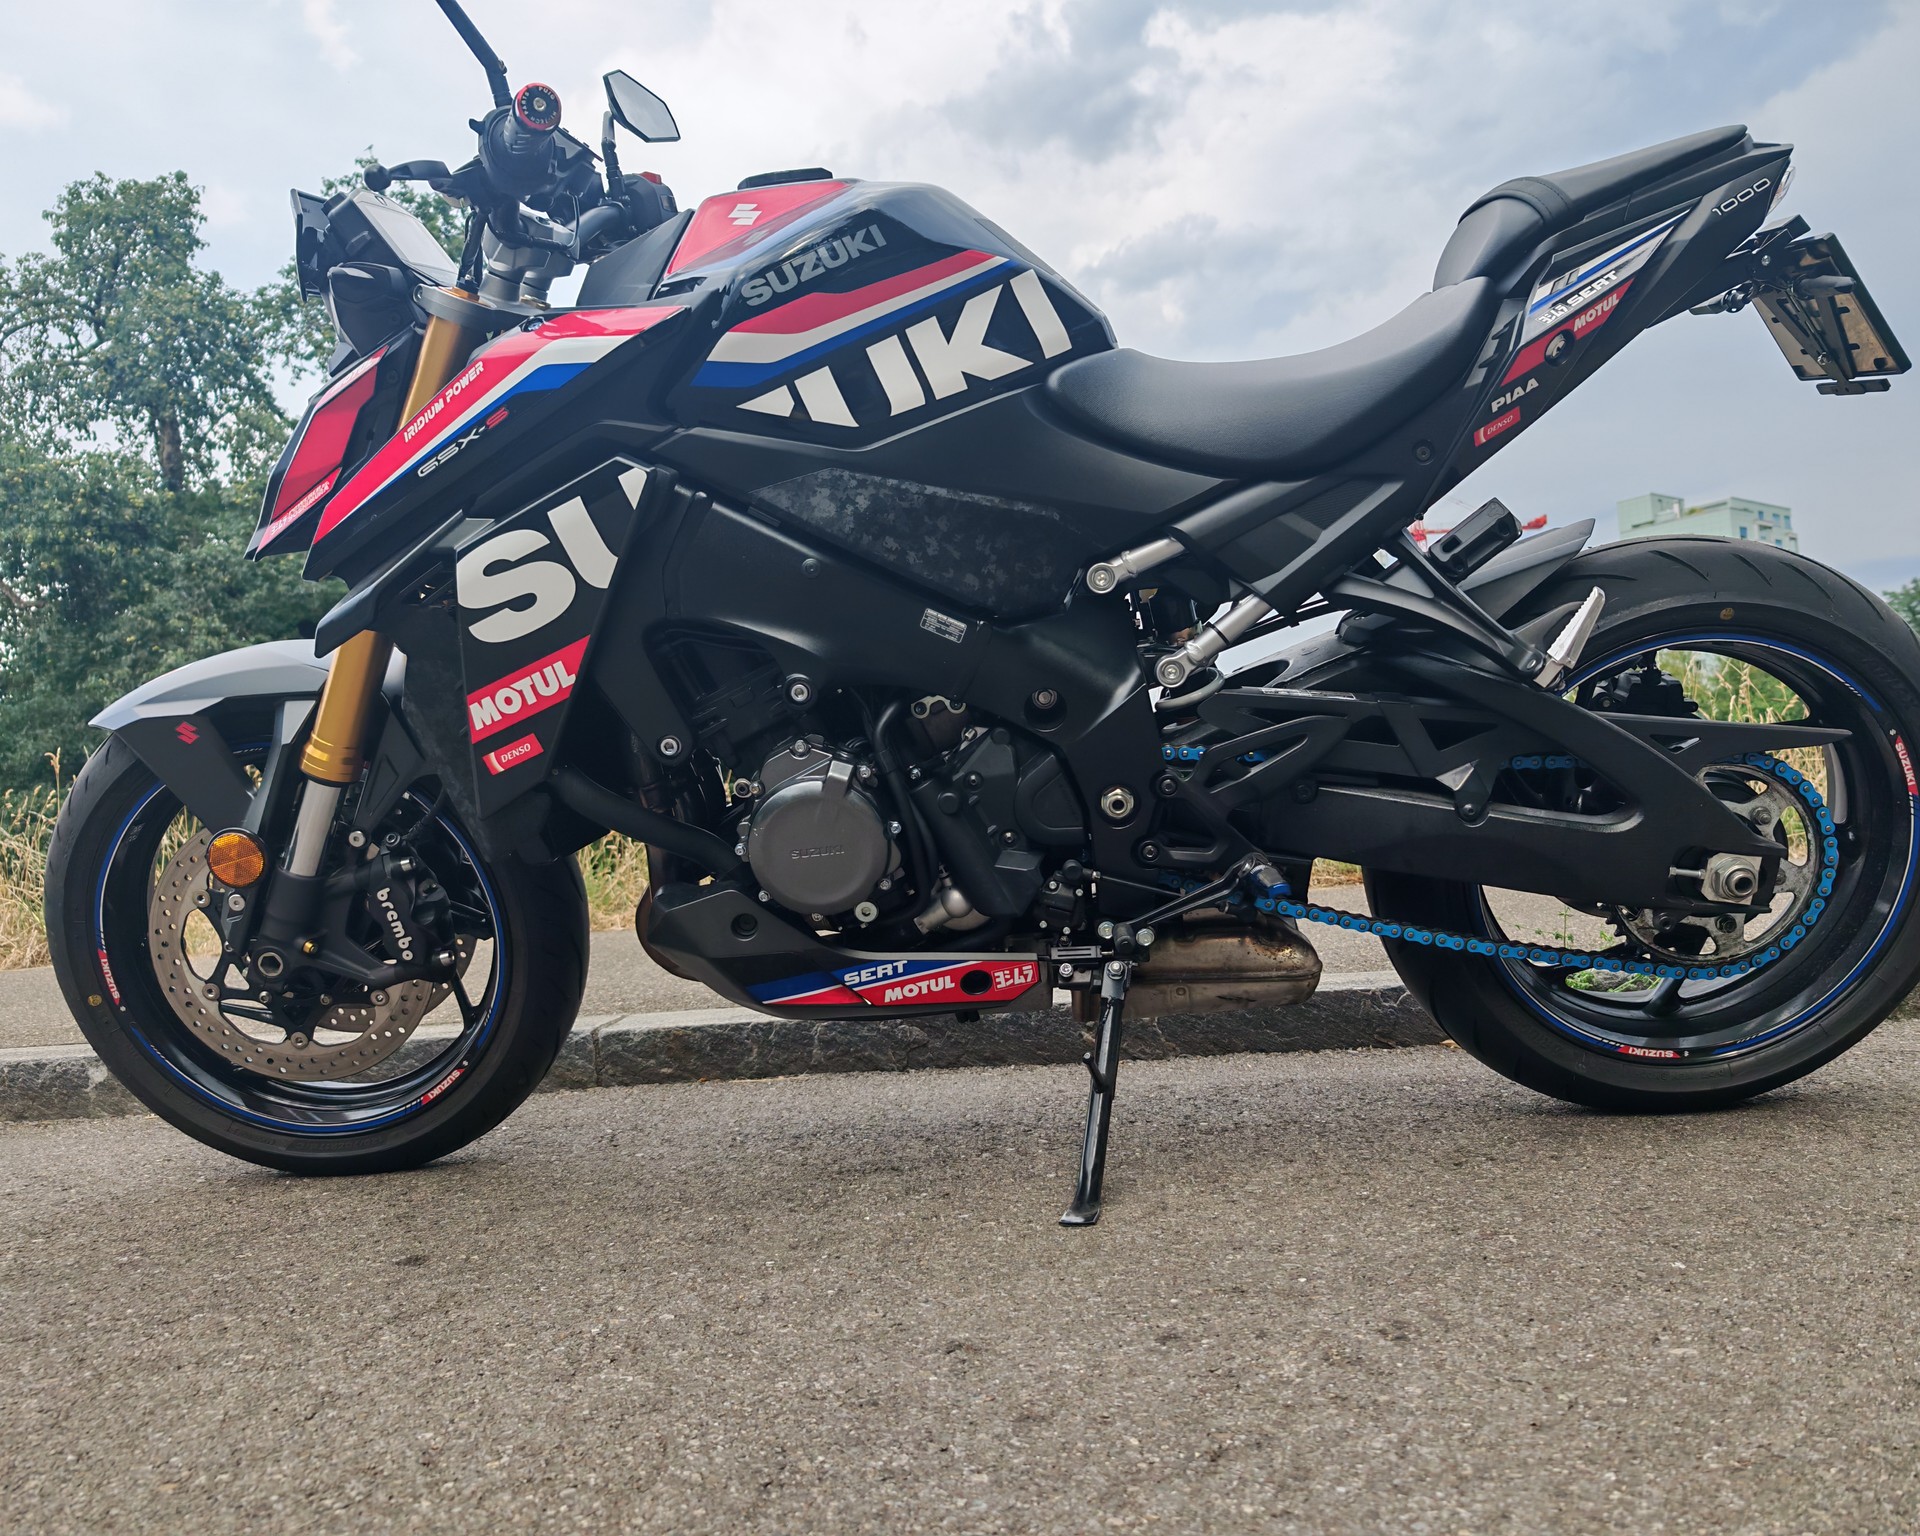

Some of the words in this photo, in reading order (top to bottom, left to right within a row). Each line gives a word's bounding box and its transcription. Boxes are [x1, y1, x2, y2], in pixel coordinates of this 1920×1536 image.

[1711, 178, 1770, 216] 1000
[741, 224, 887, 307] SUZUKI
[1573, 294, 1620, 332] MOTUL
[403, 398, 445, 443] IRIDIUM
[445, 360, 485, 403] POWER
[1491, 377, 1539, 413] PIAA
[417, 407, 509, 477] GSX-S
[1487, 415, 1514, 435] DENSO
[468, 660, 576, 731] MOTUL
[500, 743, 532, 764] DENSO
[1895, 742, 1917, 786] SUZUKI
[790, 845, 845, 860] SUZUKI
[376, 887, 414, 961] brembo
[100, 958, 121, 999] SUZUKI
[884, 975, 956, 1003] MOTUL
[1628, 1046, 1674, 1058] SUZUKI
[428, 1069, 461, 1099] SUZUKI
